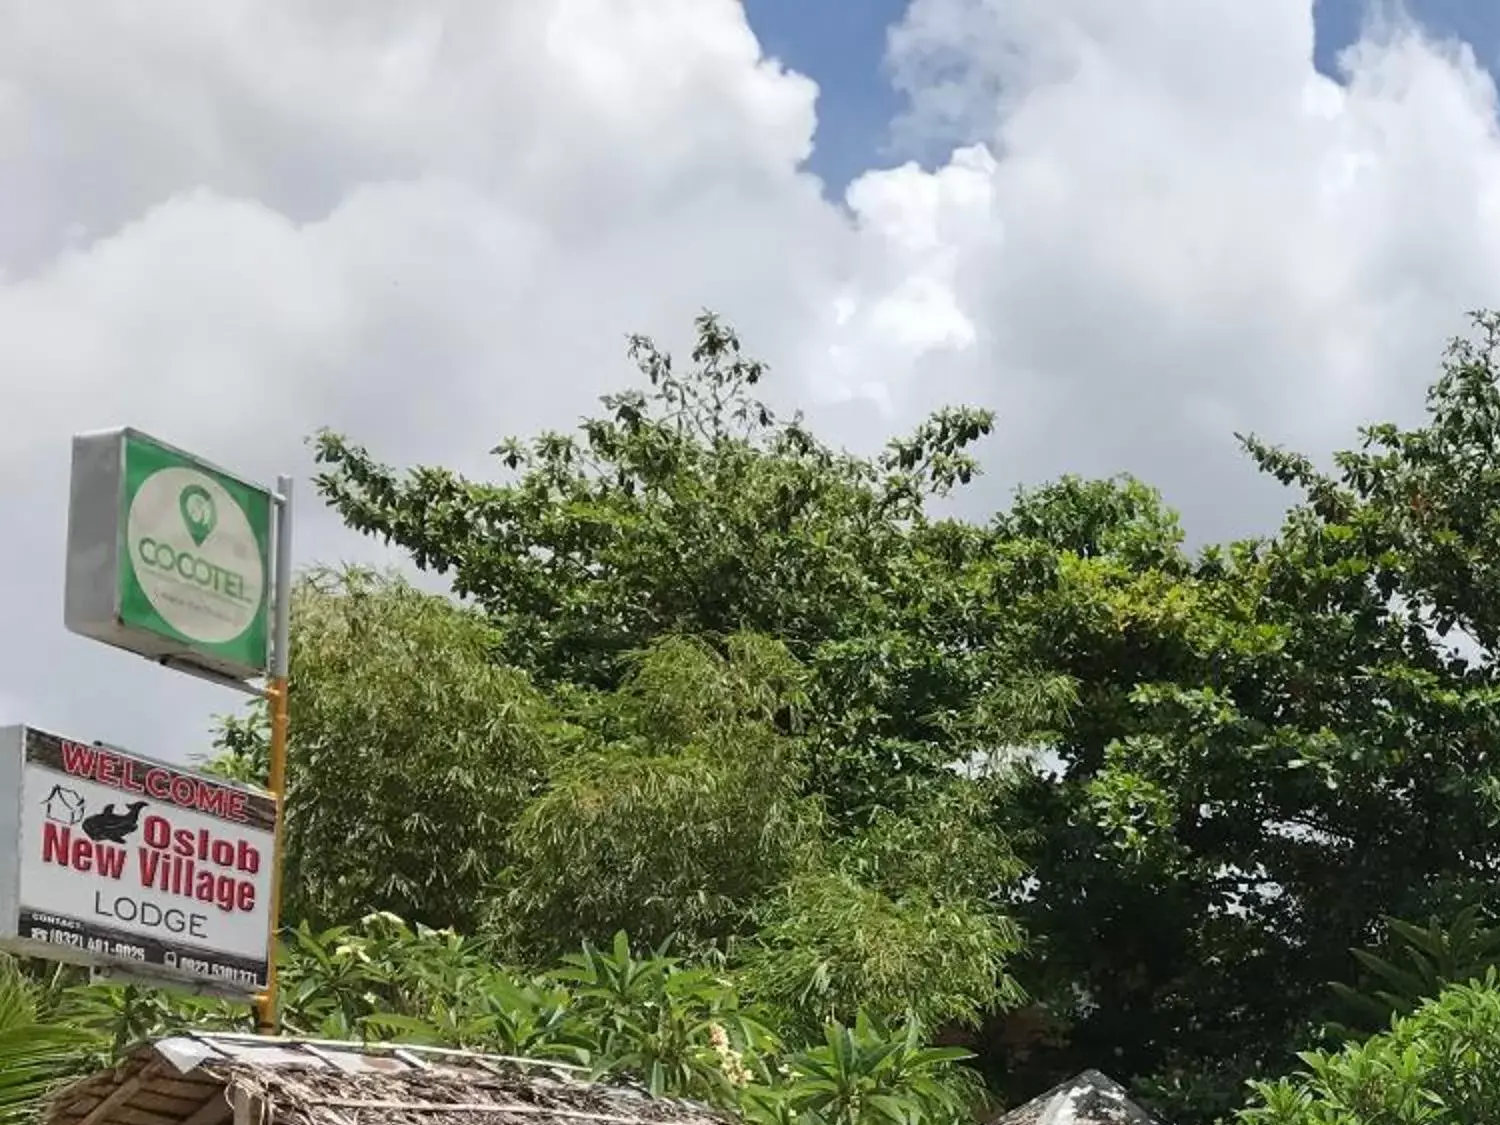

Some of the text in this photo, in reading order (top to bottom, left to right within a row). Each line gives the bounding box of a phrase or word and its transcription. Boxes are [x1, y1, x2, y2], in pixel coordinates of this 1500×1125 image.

[138, 537, 252, 603] COCOTEL
[61, 740, 249, 822] WELCOME
[42, 821, 256, 912] New Village
[144, 815, 260, 875] Oslob
[95, 890, 208, 938] LODGE
